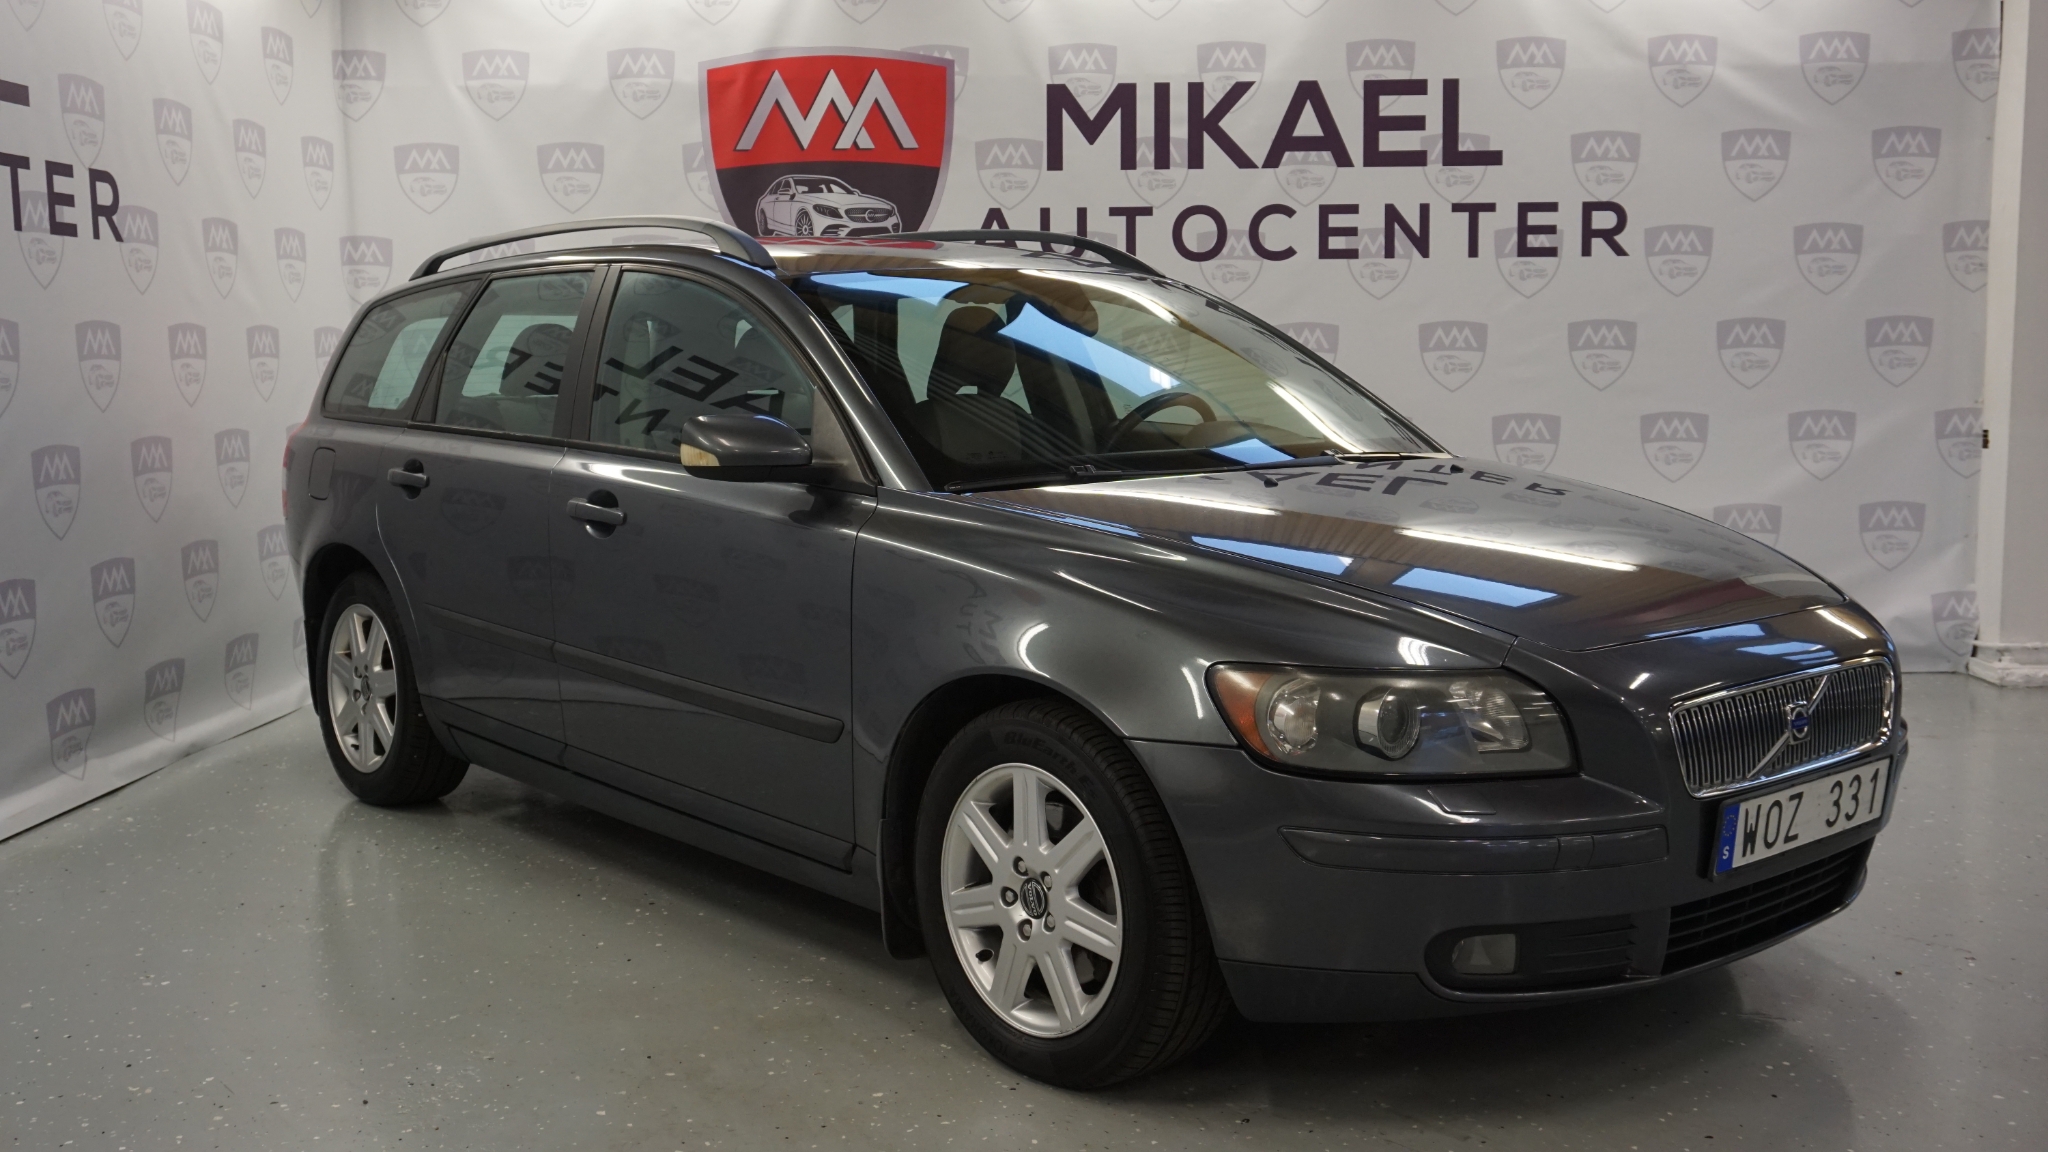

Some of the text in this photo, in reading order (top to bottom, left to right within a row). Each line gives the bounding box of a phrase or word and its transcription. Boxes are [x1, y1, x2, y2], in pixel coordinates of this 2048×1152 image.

[1046, 78, 1503, 171] MIKAEL
[1722, 846, 1730, 860] S
[1742, 767, 1879, 857] WOZ 331
